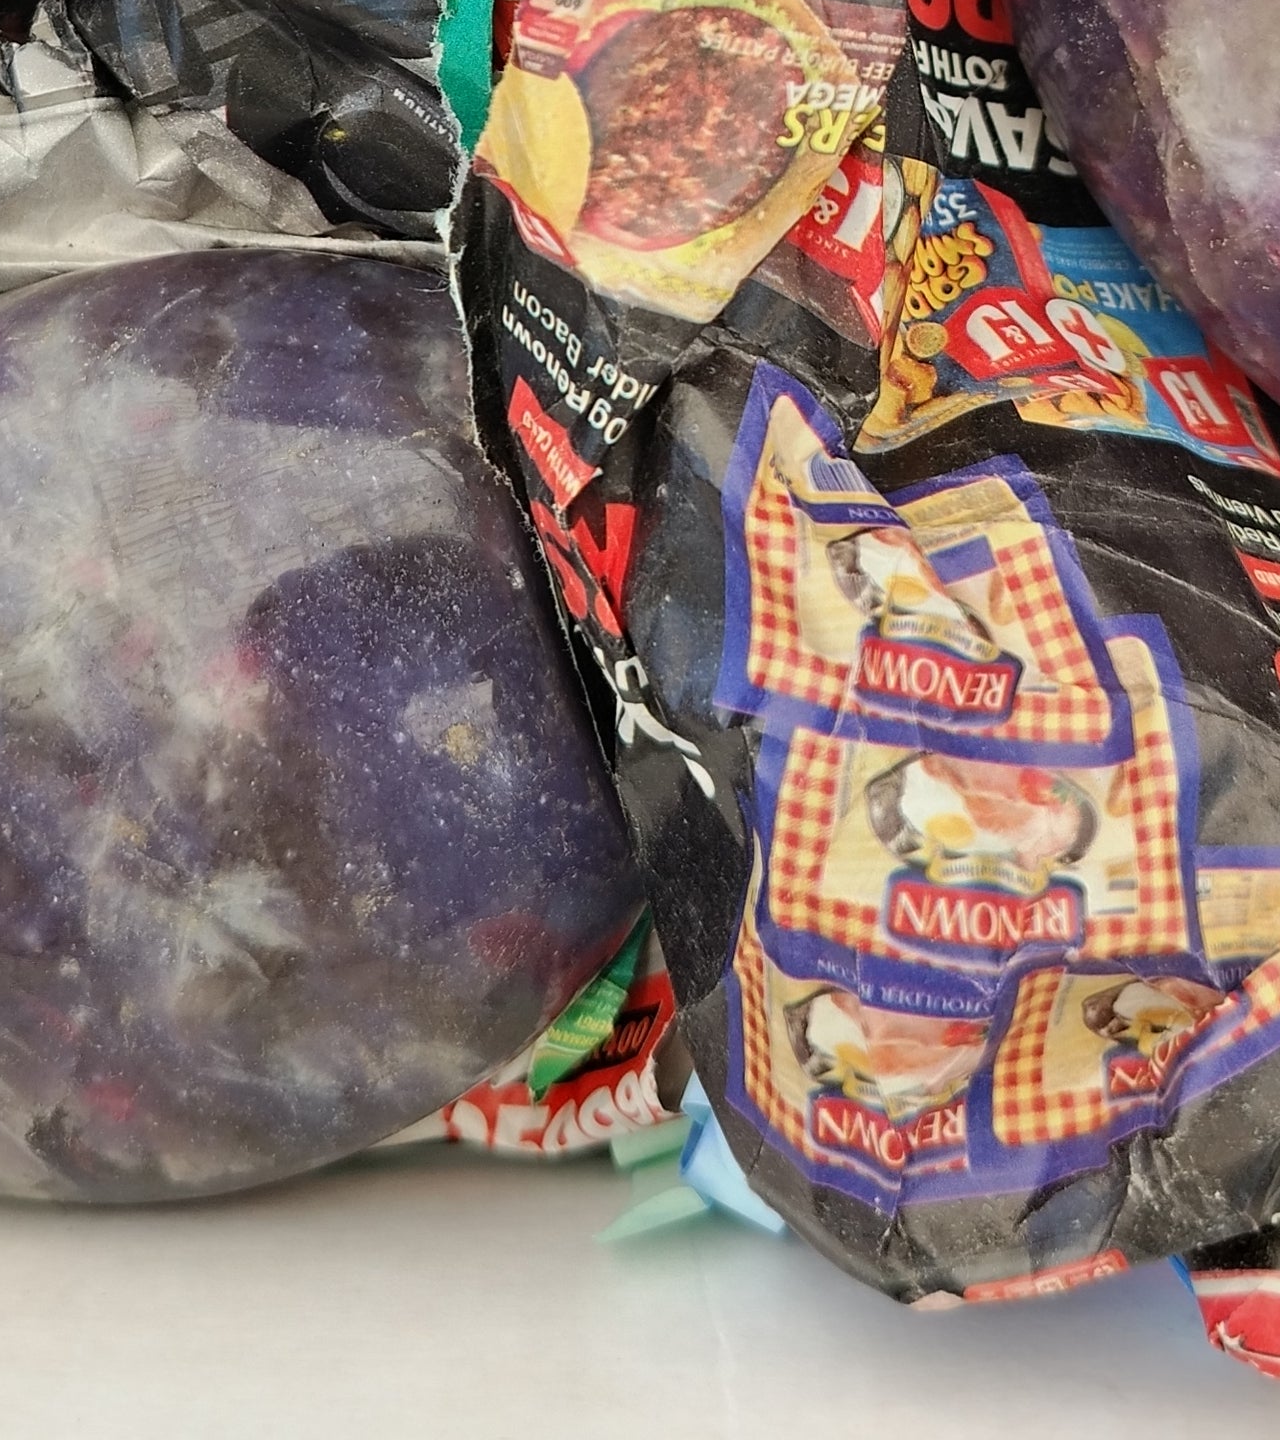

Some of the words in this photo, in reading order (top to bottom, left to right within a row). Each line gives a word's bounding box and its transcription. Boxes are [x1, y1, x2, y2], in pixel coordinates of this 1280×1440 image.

[786, 80, 887, 113] MEGA
[512, 279, 583, 369] Bacon
[966, 300, 1055, 361] I&J
[501, 304, 591, 414] Renown
[548, 450, 582, 499] WITH
[1186, 473, 1274, 528] Viennas
[859, 642, 1010, 709] RENOWN
[896, 889, 1074, 943] RENOWN
